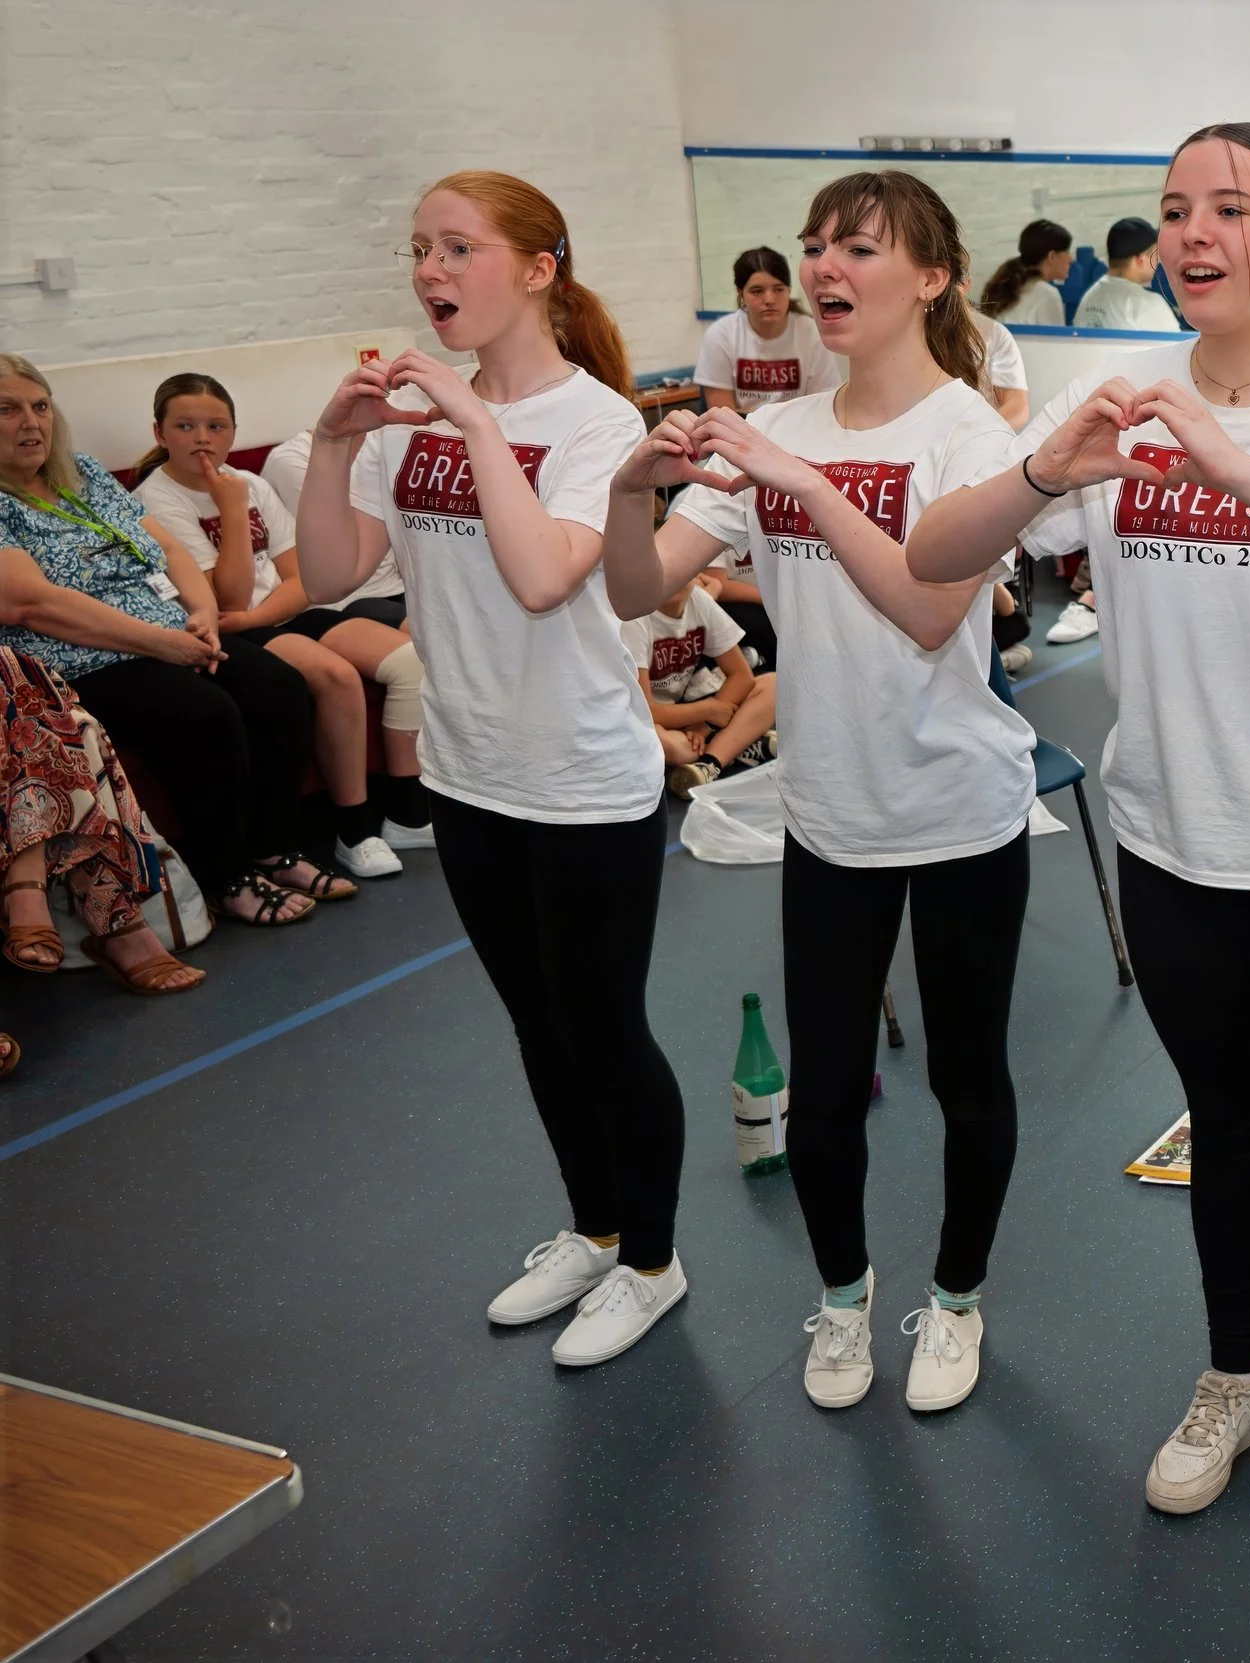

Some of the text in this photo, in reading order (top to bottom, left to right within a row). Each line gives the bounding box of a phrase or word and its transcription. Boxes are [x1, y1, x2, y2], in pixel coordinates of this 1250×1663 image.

[743, 366, 797, 384] GREASE
[438, 441, 453, 452] WE
[421, 495, 440, 508] THE
[447, 499, 476, 511] MUSI
[401, 513, 476, 536] DOSYTCo
[779, 517, 799, 531] THE
[1132, 516, 1143, 529] 19
[1152, 517, 1178, 532] THE
[767, 538, 838, 561] DSYTCo
[1120, 540, 1226, 565] DOSYTCo
